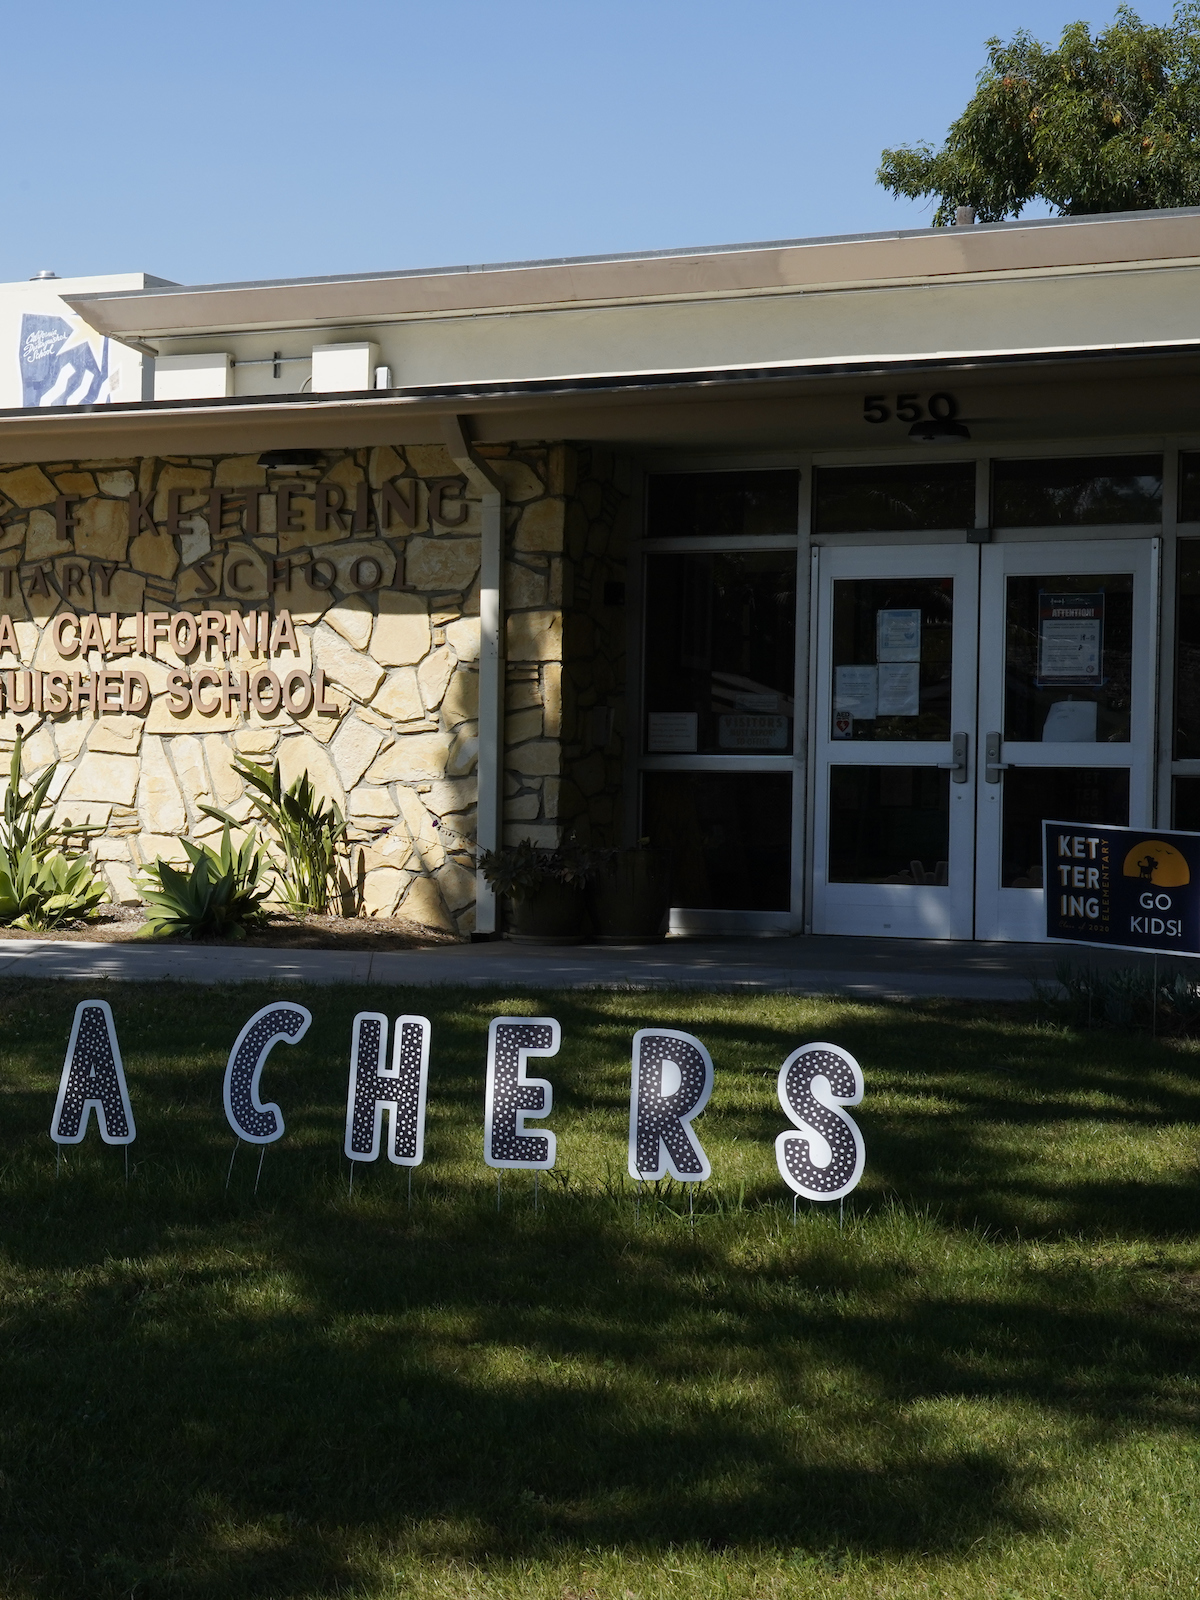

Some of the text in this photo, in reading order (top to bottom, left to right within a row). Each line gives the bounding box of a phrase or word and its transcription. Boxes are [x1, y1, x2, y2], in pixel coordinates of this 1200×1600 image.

[28, 344, 55, 362] School
[863, 392, 957, 423] 550
[56, 494, 80, 541] F
[128, 479, 468, 537] KETTERING
[194, 555, 416, 595] SCHOOL
[1051, 607, 1095, 618] ATTENTION!
[52, 608, 300, 658] CALIFORNIA
[165, 668, 339, 716] SCHOOL
[724, 717, 783, 728] VISITORS
[729, 729, 777, 737] MUST REPORT
[1058, 835, 1099, 860] KET
[1057, 864, 1100, 890] TER
[1102, 838, 1110, 922] ELEMENTARY
[1060, 894, 1100, 919] ING
[1139, 891, 1173, 911] GO
[1088, 924, 1110, 933] 2020
[1130, 915, 1183, 938] KIDS!
